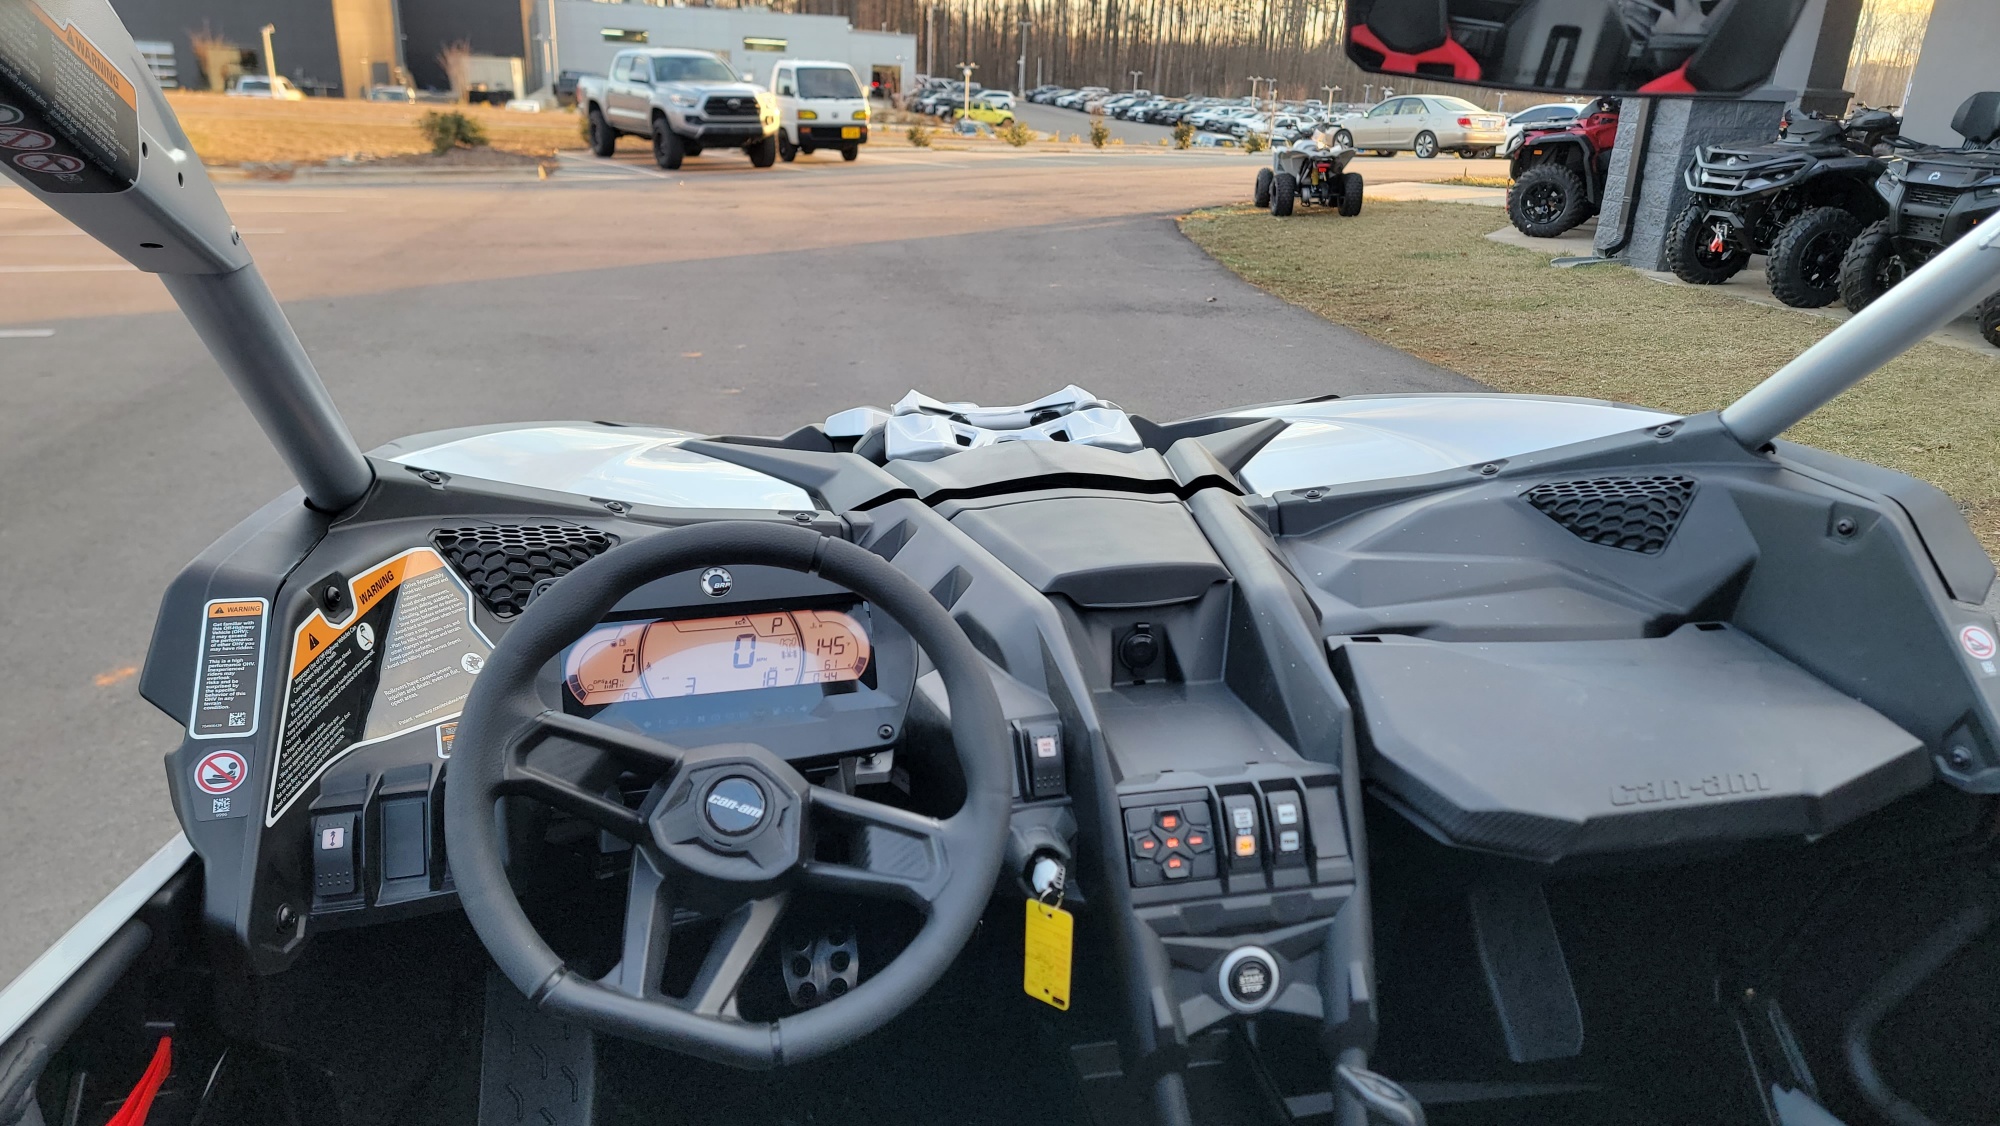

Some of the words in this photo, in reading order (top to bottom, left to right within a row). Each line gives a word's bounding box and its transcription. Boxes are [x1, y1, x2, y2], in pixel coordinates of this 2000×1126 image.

[74, 36, 120, 90] WARNING
[358, 570, 395, 606] WARNING
[404, 581, 417, 590] Drive
[416, 572, 444, 587] Responsibly
[227, 605, 261, 613] WARNING
[772, 617, 782, 633] P
[733, 634, 756, 669] 0
[816, 636, 845, 656] 145
[622, 653, 636, 673] 0
[1610, 772, 1771, 806] can-am
[708, 794, 764, 818] can-am
